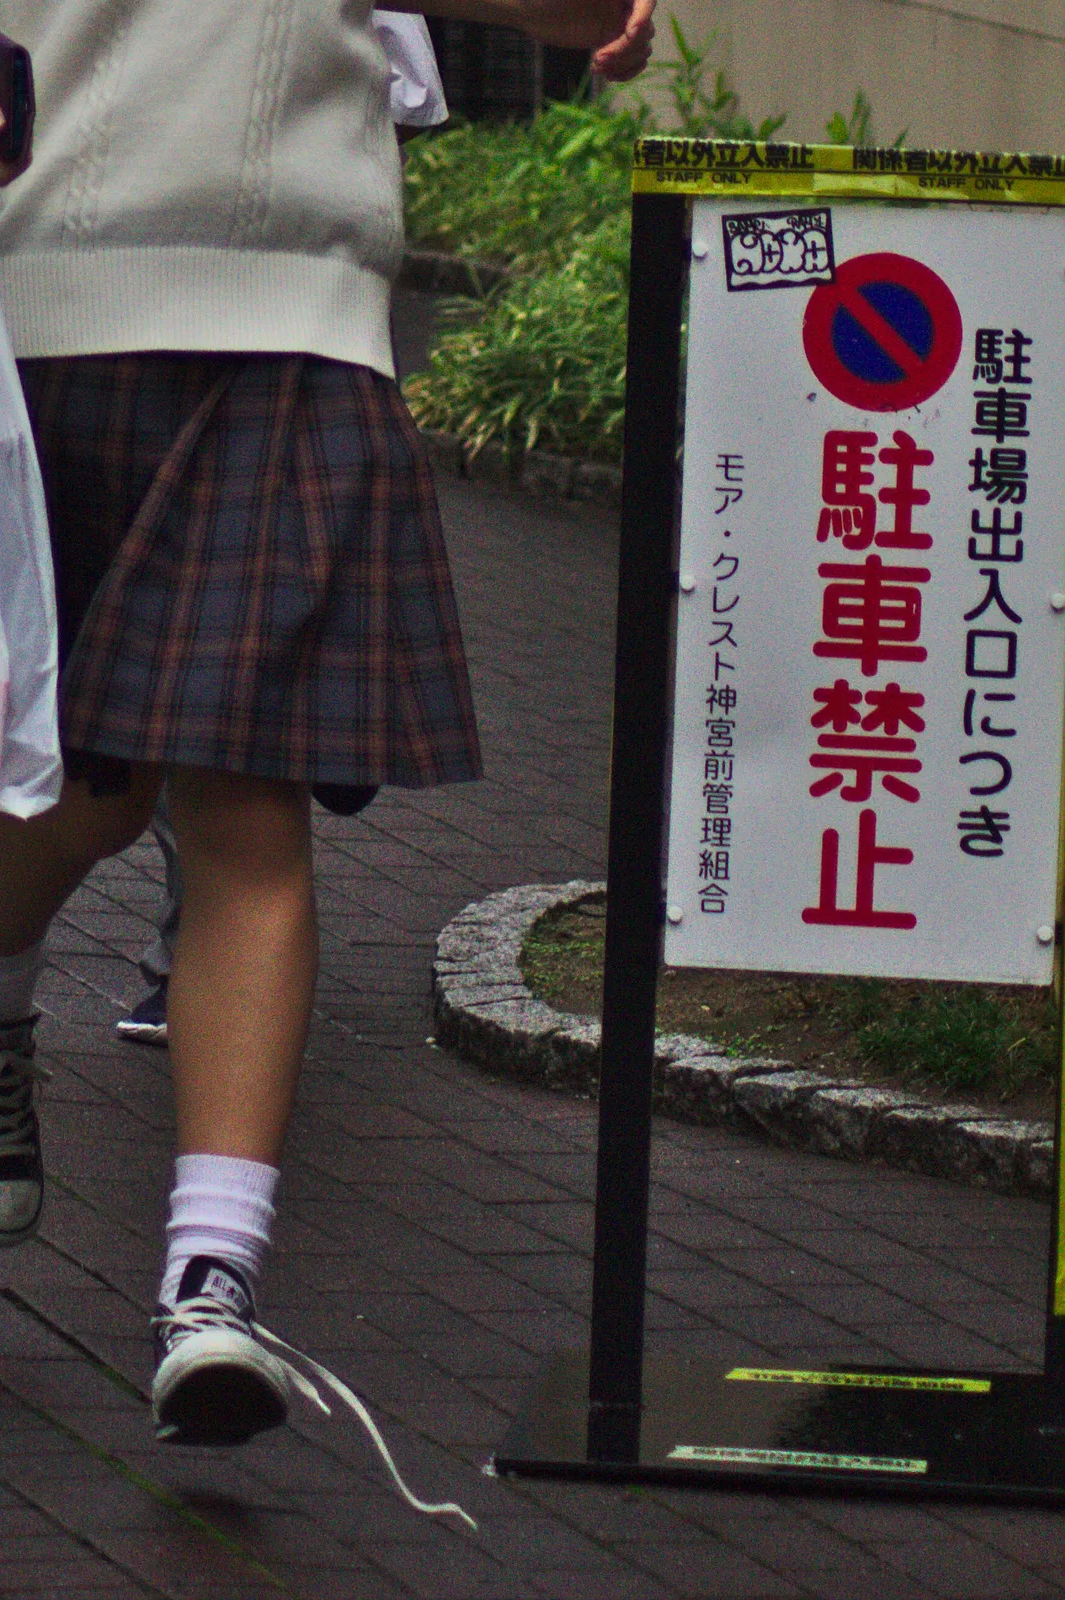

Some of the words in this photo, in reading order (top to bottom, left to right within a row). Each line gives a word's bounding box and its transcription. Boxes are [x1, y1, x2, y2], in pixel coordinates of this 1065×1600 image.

[634, 139, 815, 169] 者以外立入禁止
[656, 170, 703, 183] STAFF
[711, 171, 752, 184] ONLY
[918, 176, 966, 189] STAFF
[974, 177, 1015, 191] ONLY
[697, 452, 745, 914] モア・クレスト神宮前管理組合
[800, 429, 934, 931] 駐車禁止
[957, 328, 1033, 858] 駐車場出入口につき
